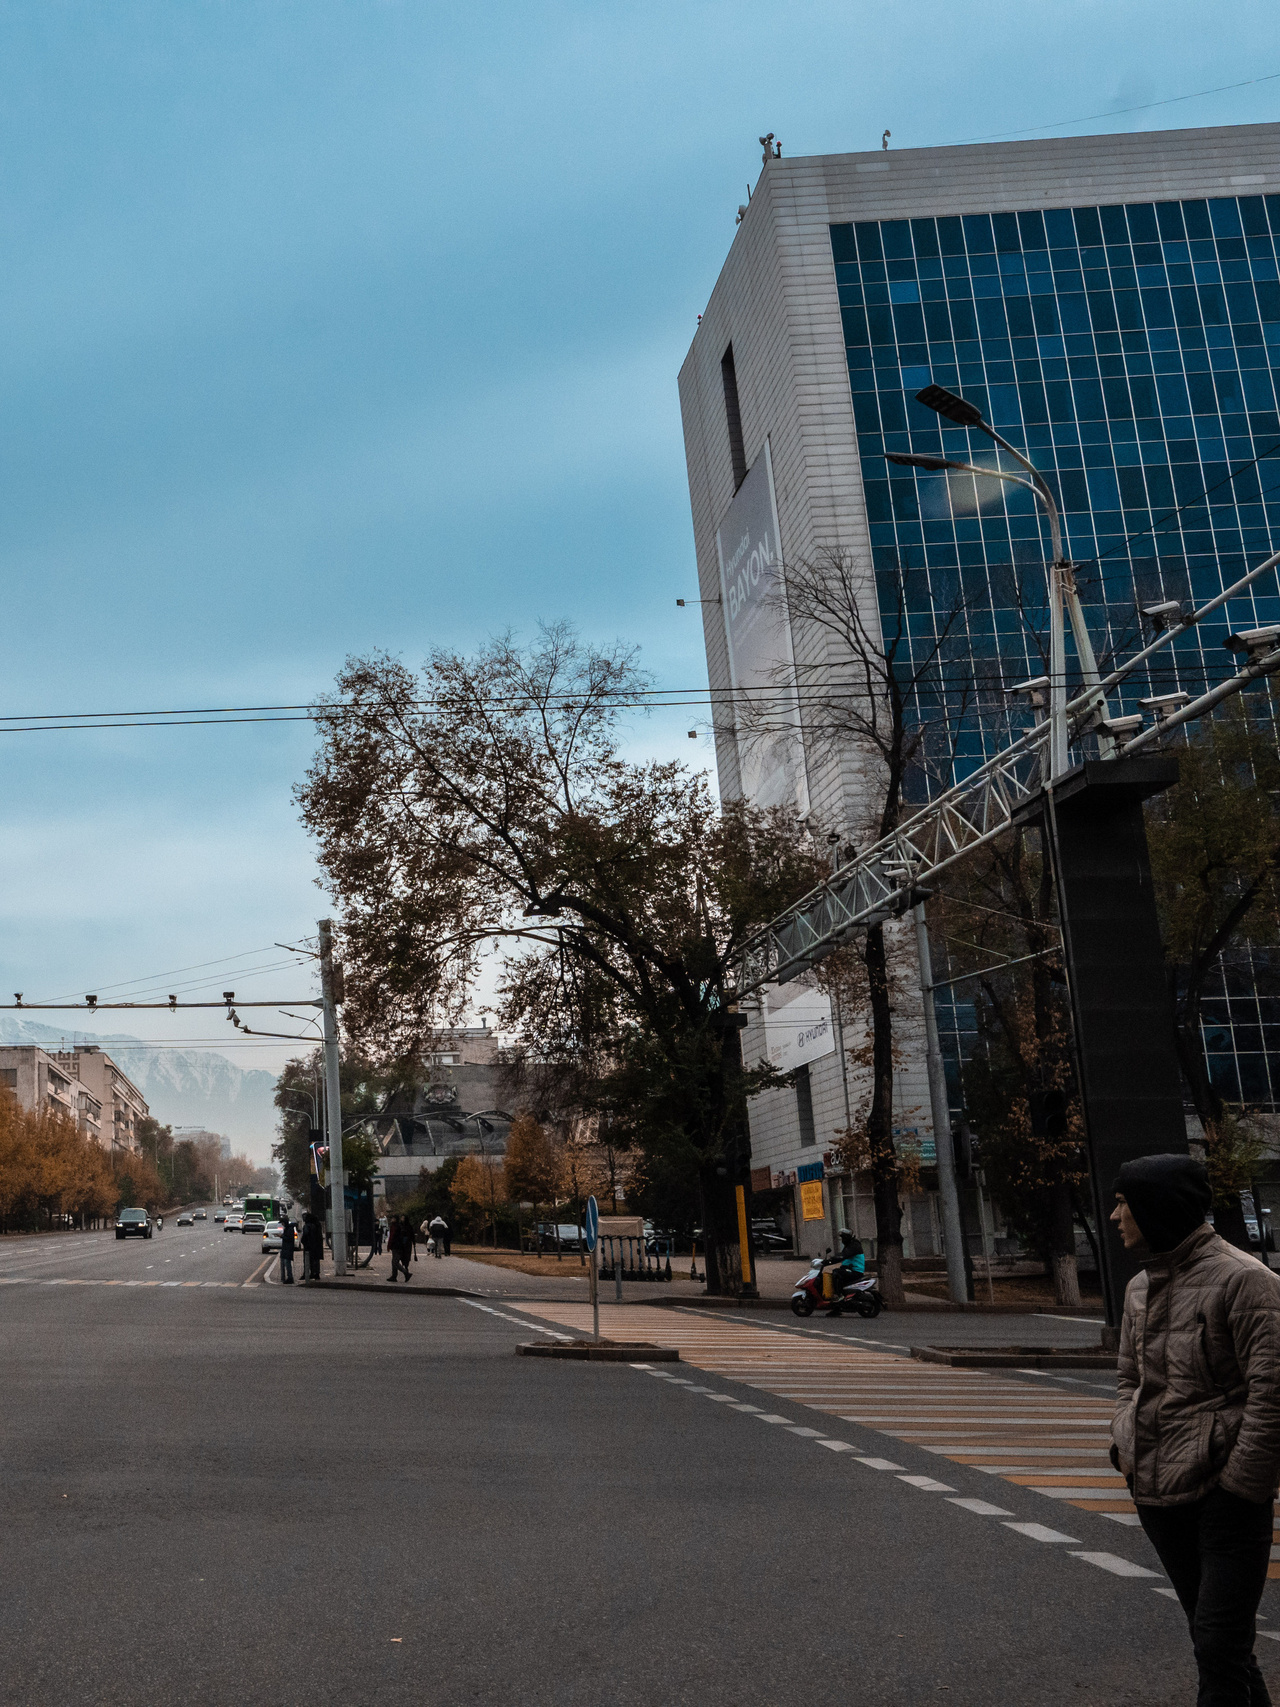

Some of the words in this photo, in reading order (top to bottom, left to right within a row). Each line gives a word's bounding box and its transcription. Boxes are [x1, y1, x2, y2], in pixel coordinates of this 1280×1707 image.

[725, 525, 750, 579] Hyundai
[728, 531, 774, 622] BAYON.
[805, 1022, 829, 1043] HYUNDAI
